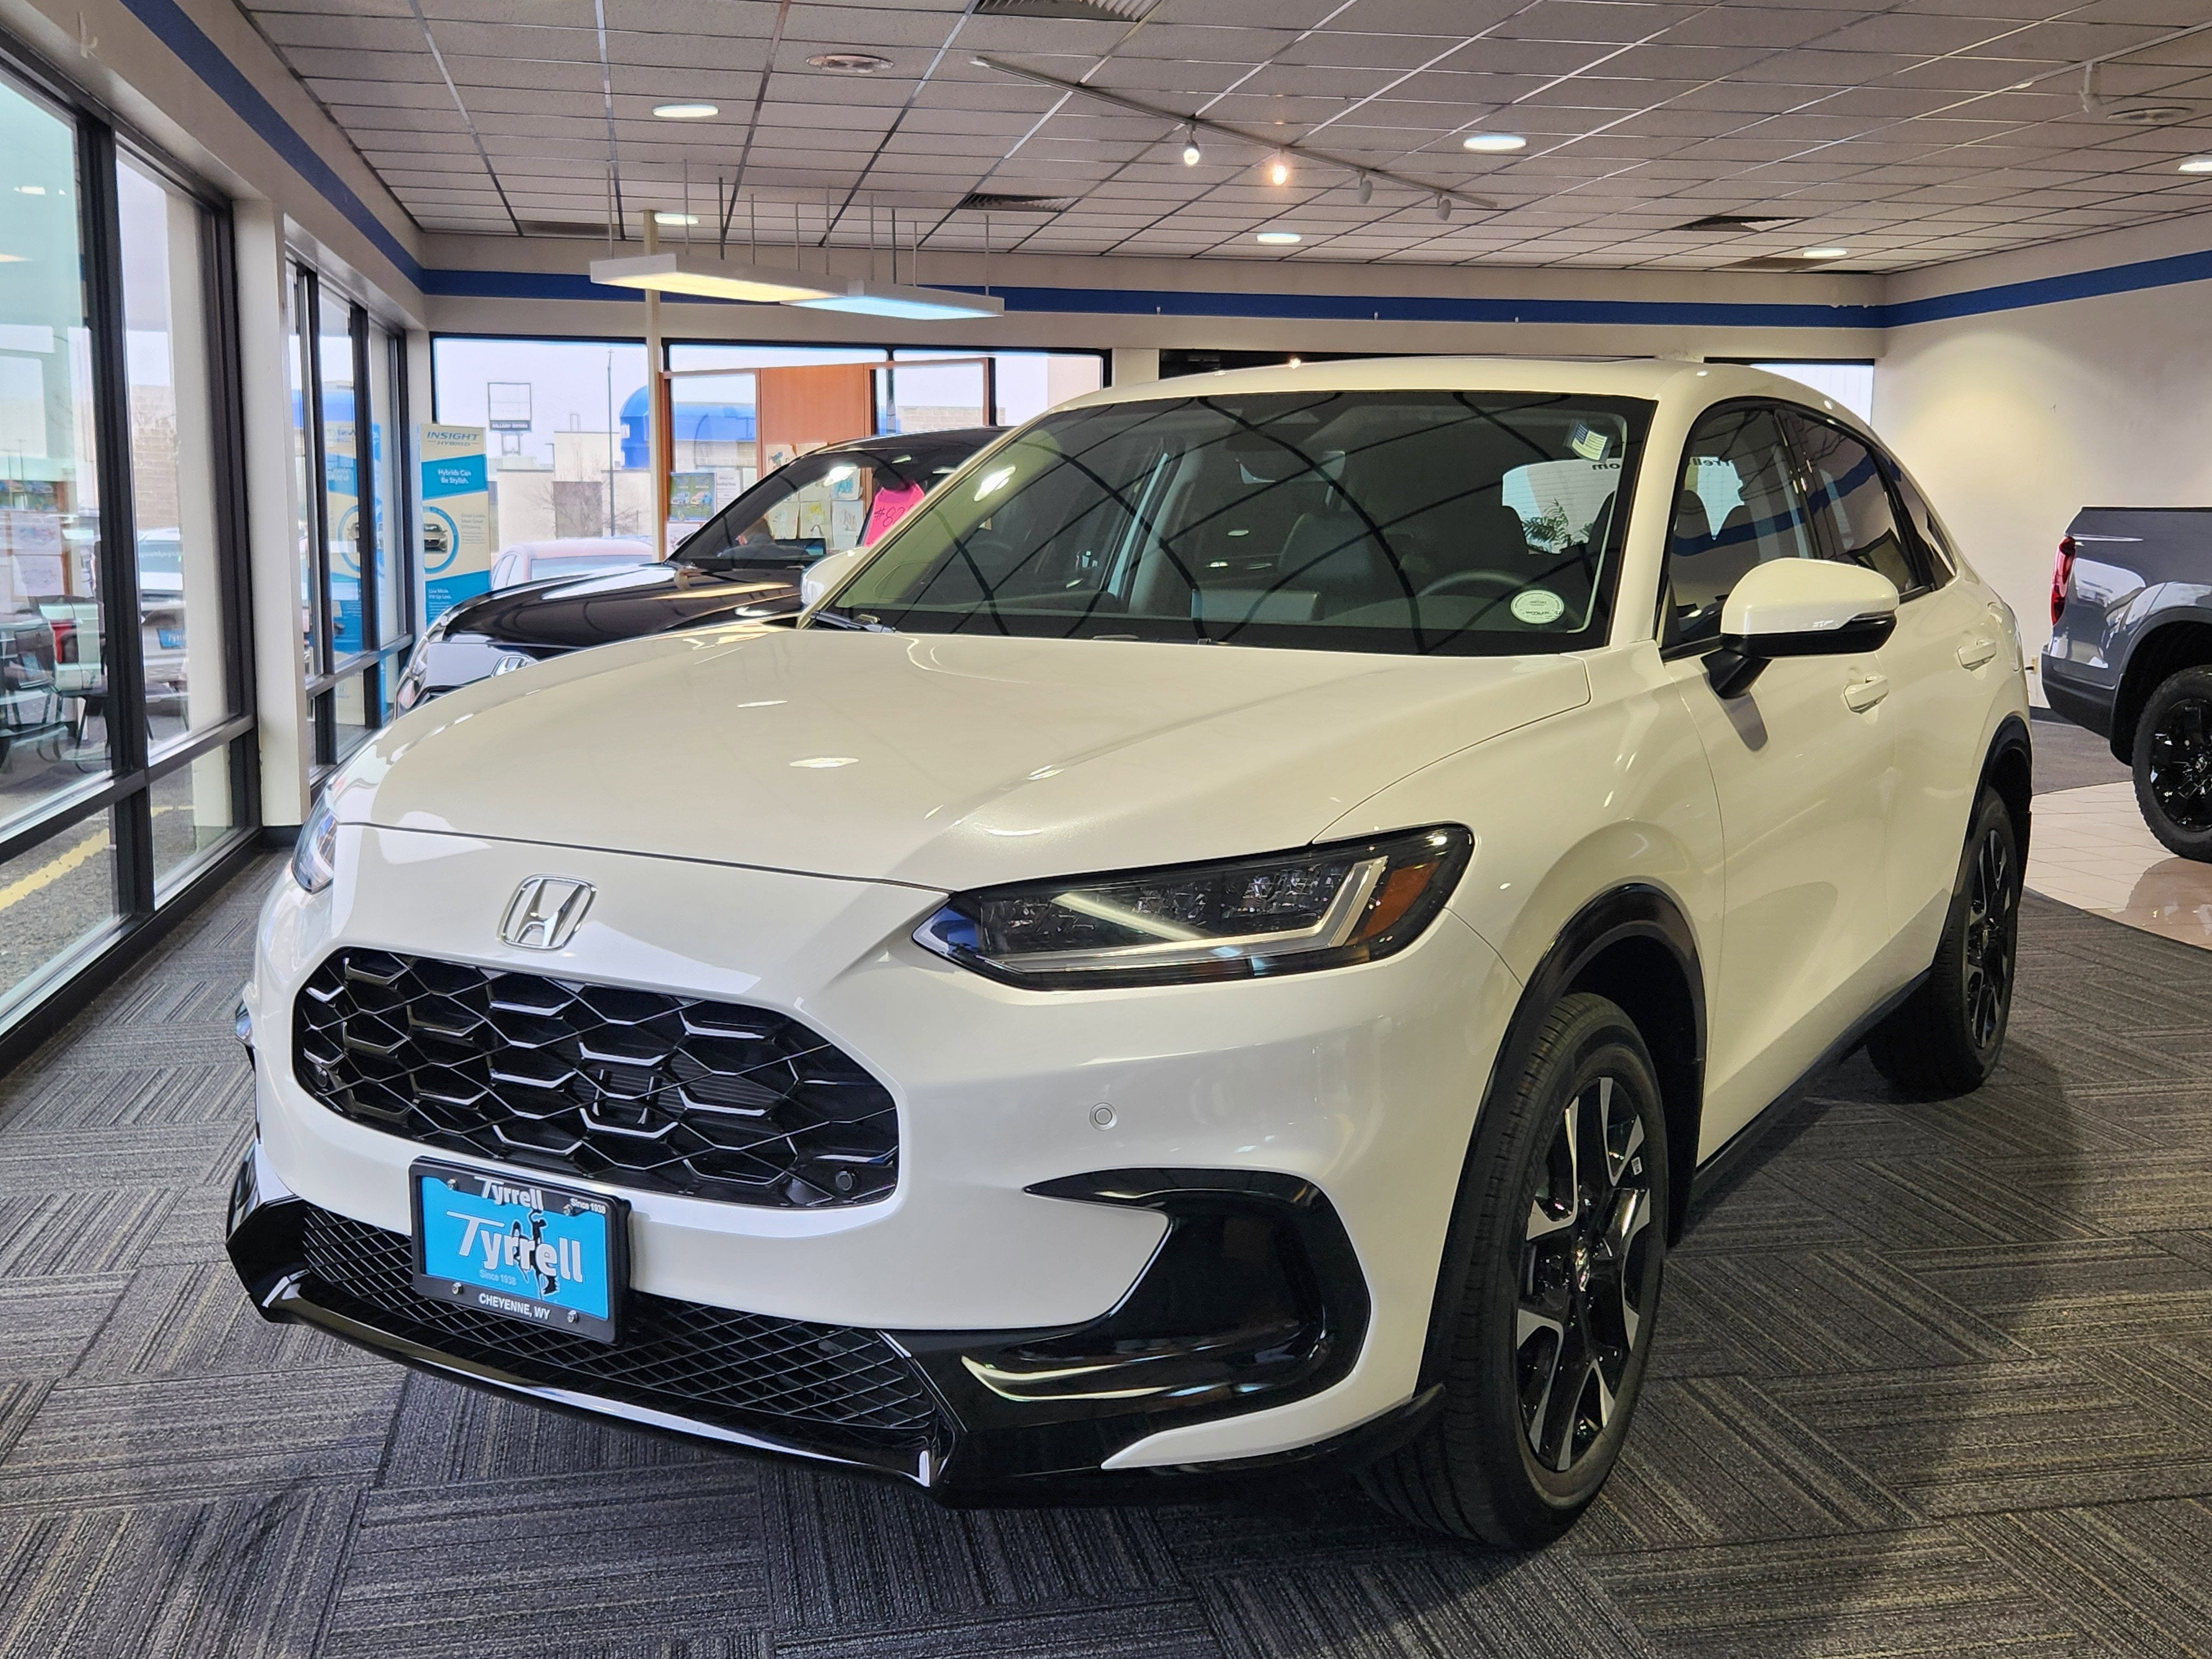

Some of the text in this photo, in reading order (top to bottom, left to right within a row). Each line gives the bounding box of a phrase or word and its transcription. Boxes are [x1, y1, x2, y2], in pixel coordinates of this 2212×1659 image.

[427, 431, 480, 440] INSIGHT
[438, 468, 460, 477] Hybrids
[474, 1176, 544, 1211] Tyrrell
[570, 1197, 606, 1214] Since 1938
[446, 1210, 583, 1284] Tyrrell
[479, 1269, 517, 1286] Since 1938
[478, 1292, 550, 1320] CHEYENNE, WY
